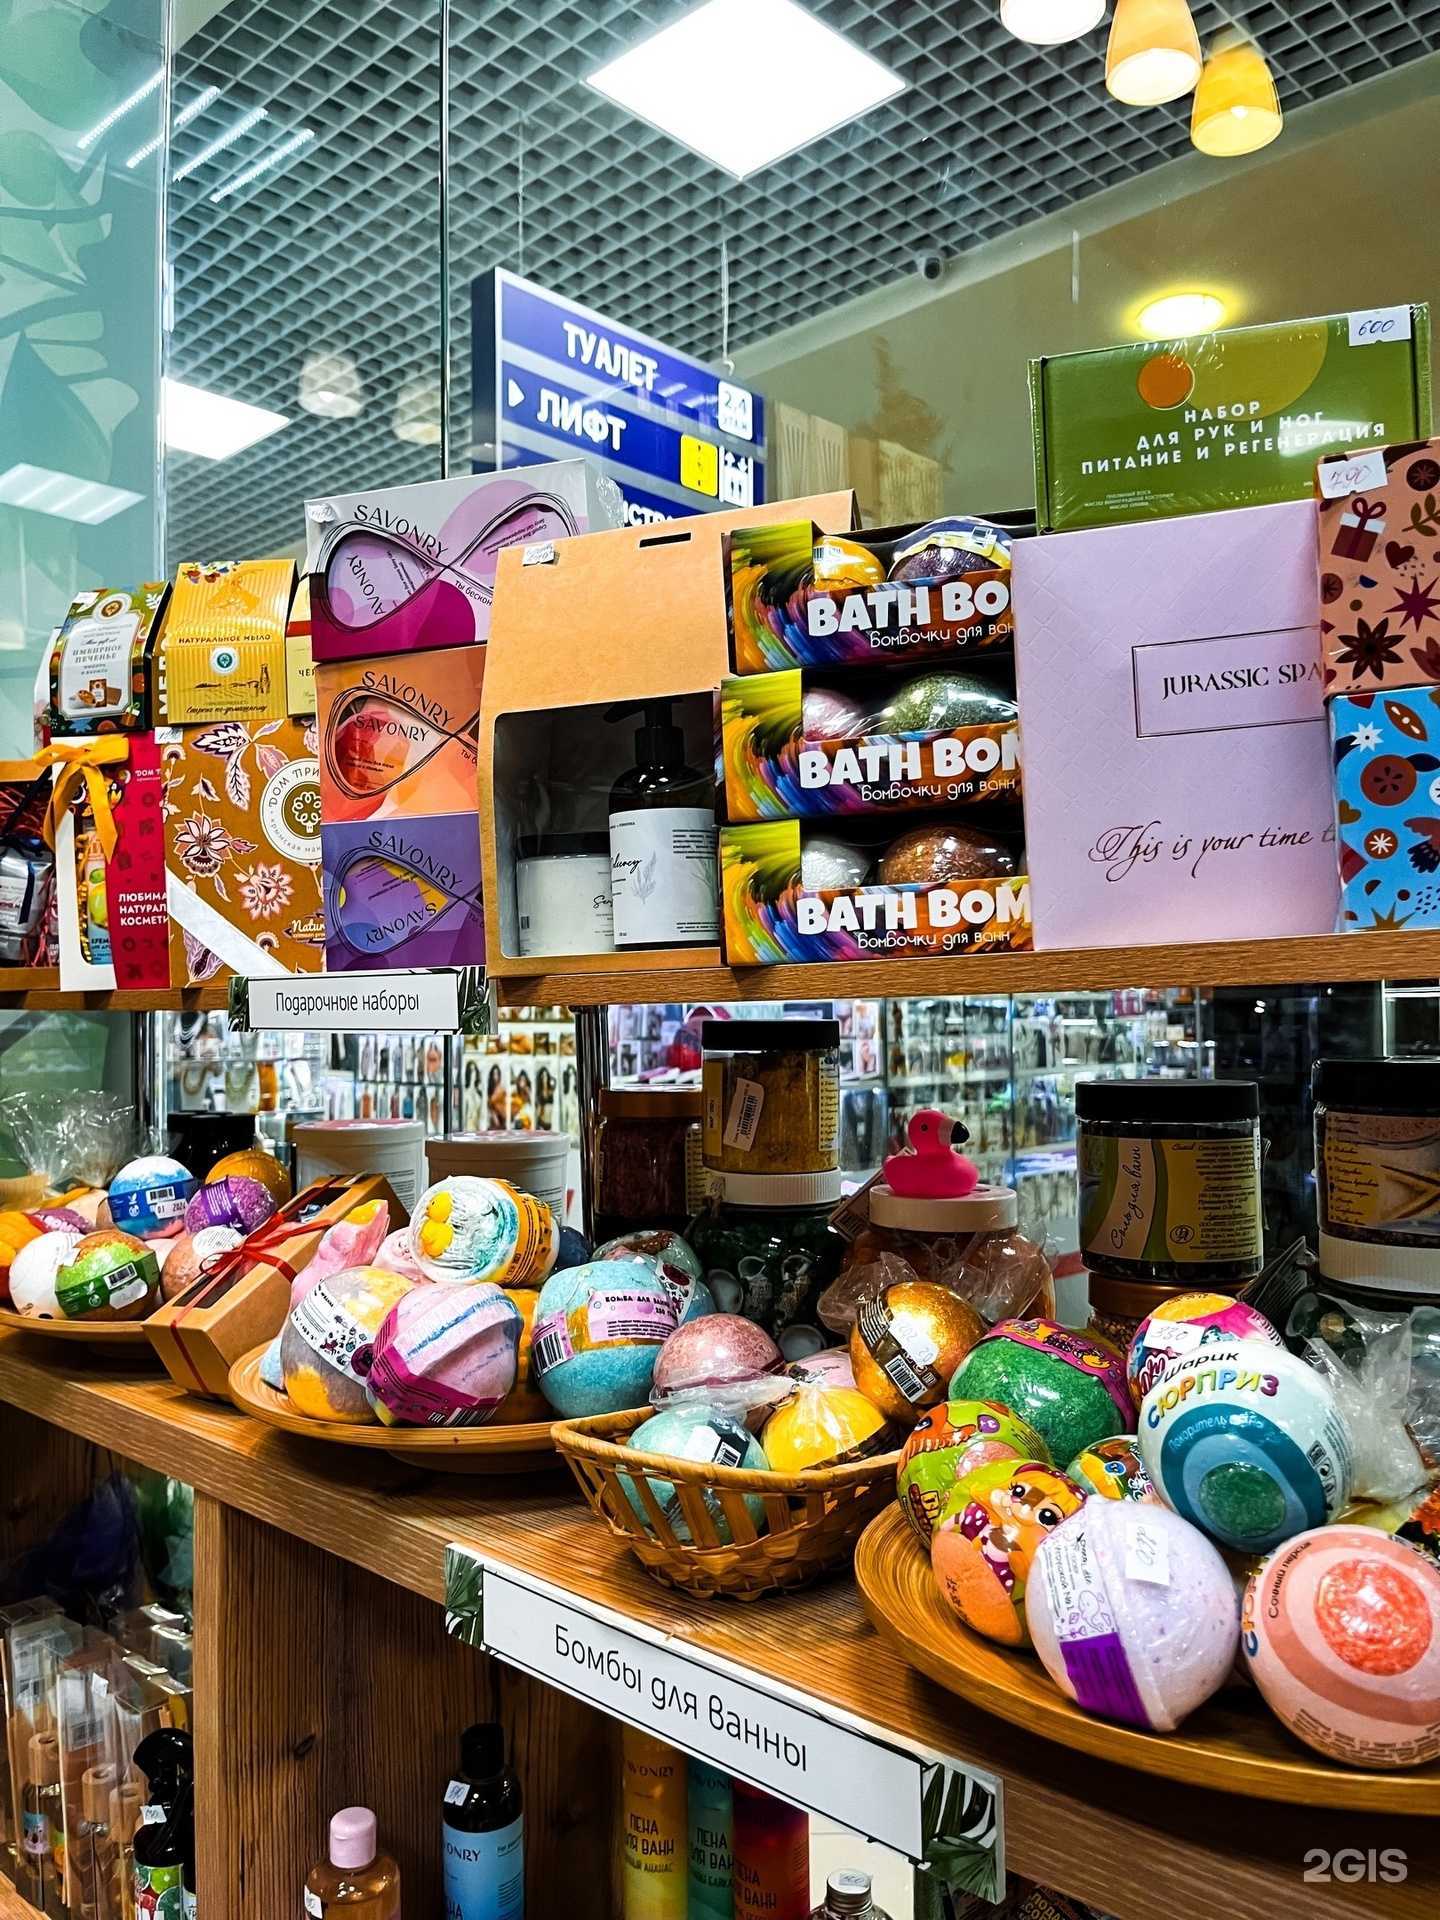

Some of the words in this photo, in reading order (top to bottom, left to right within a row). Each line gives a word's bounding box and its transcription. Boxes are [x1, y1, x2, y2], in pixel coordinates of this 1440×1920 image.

[1358, 319, 1395, 336] 600
[563, 321, 659, 391] ТУАЛЕТ
[537, 388, 626, 451] ЛИФТ
[1185, 401, 1260, 424] НАБОР
[1137, 430, 1179, 450] ДЛЯ
[1194, 423, 1234, 442] РУК
[1250, 420, 1263, 434] И
[1280, 411, 1323, 429] НОГ
[1081, 452, 1182, 475] ПИТАНИЕ
[1197, 447, 1209, 460] И
[1225, 423, 1385, 456] РЕГЕНЕРАЦИЯ
[353, 504, 448, 560] SAVONRY
[346, 554, 387, 616] AVONRY
[465, 587, 493, 606] бескон
[807, 588, 930, 637] BATH
[942, 580, 1009, 622] BO
[179, 636, 241, 645] НАТУРАЛЬНОЕ
[870, 627, 949, 648] Бомбочки
[957, 625, 982, 645] для
[988, 622, 1014, 635] ван
[1161, 666, 1268, 700] JURASSIC
[1278, 662, 1323, 685] SPA
[362, 670, 455, 728] SAVONRY
[354, 715, 429, 742] SAVONRY
[799, 740, 922, 789] BATH
[269, 777, 290, 808] ДОМ
[292, 767, 320, 781] ПРИ
[861, 783, 941, 802] Бомбочки
[947, 782, 973, 800] для
[980, 779, 1015, 791] ванн
[369, 831, 463, 890] SAVONRY
[1088, 821, 1163, 882] This
[1173, 834, 1192, 860] is
[1190, 833, 1253, 878] your
[1259, 826, 1312, 848] time
[118, 892, 168, 903] ЛЮБИМА
[120, 904, 167, 914] НАТУРАЛ
[796, 892, 918, 935] BATH
[928, 884, 1032, 928] BOM
[121, 915, 169, 926] КОСМЕТИ
[366, 903, 437, 948] SAVONRY
[857, 932, 937, 949] Бомбочки
[944, 933, 968, 950] для
[974, 930, 1010, 943] ванн
[275, 992, 358, 1016] Подарочные
[362, 989, 420, 1015] наборы
[1164, 1352, 1240, 1384] шарик
[1148, 1369, 1280, 1429] СЮРПРИЗ
[1268, 1570, 1286, 1618] Сочный
[554, 1624, 642, 1693] Бомбы
[651, 1675, 698, 1720] для
[707, 1694, 808, 1772] ванны
[630, 1813, 659, 1836] ПЕНА
[696, 1827, 728, 1850] ПЕНА
[446, 1842, 481, 1861] ONRY
[642, 1839, 674, 1856] ВАНН
[710, 1851, 734, 1870] ВАН
